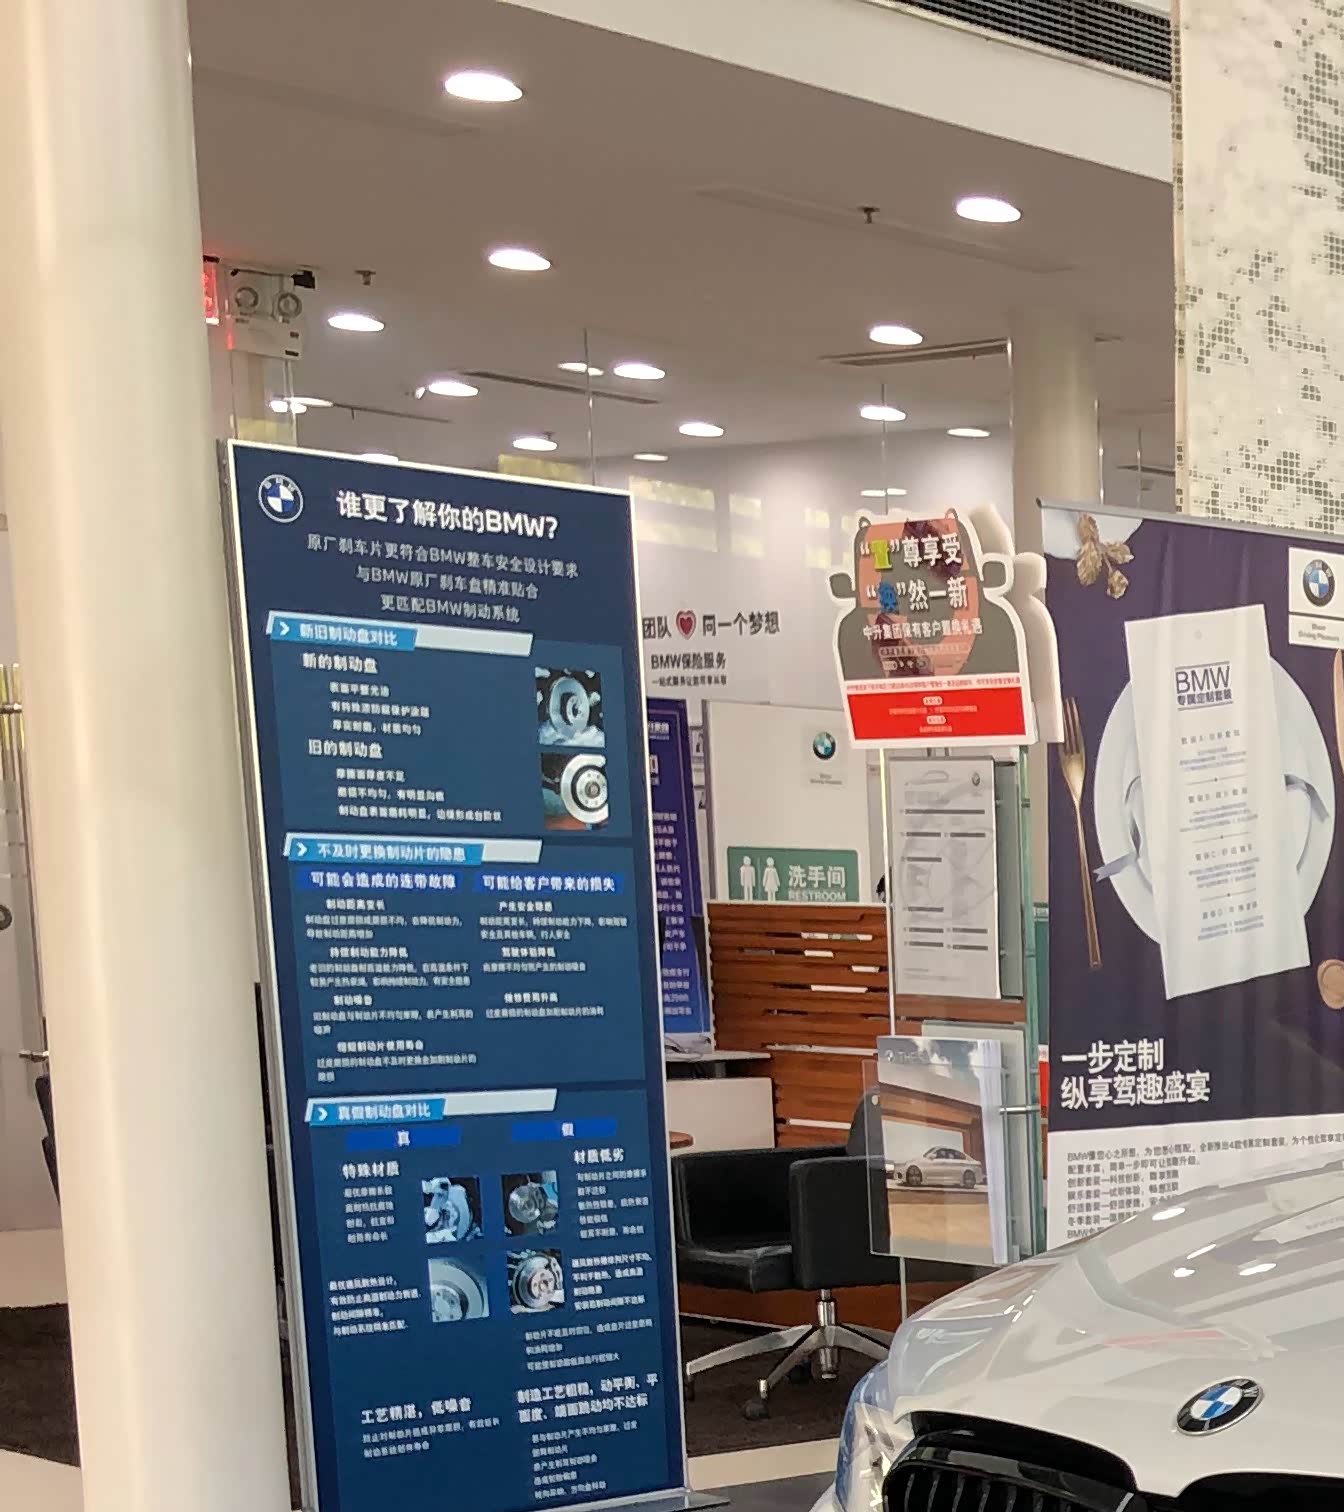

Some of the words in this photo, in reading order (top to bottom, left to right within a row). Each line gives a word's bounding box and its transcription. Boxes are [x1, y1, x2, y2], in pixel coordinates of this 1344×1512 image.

[336, 490, 559, 540] 谁更了解你的BMW?
[702, 610, 780, 636] 同一个梦想
[1175, 666, 1230, 694] BMW
[788, 864, 846, 889] 洗手间
[1061, 1038, 1165, 1074] 一步定制
[1060, 1070, 1211, 1110] 纵享驾趣盛宴
